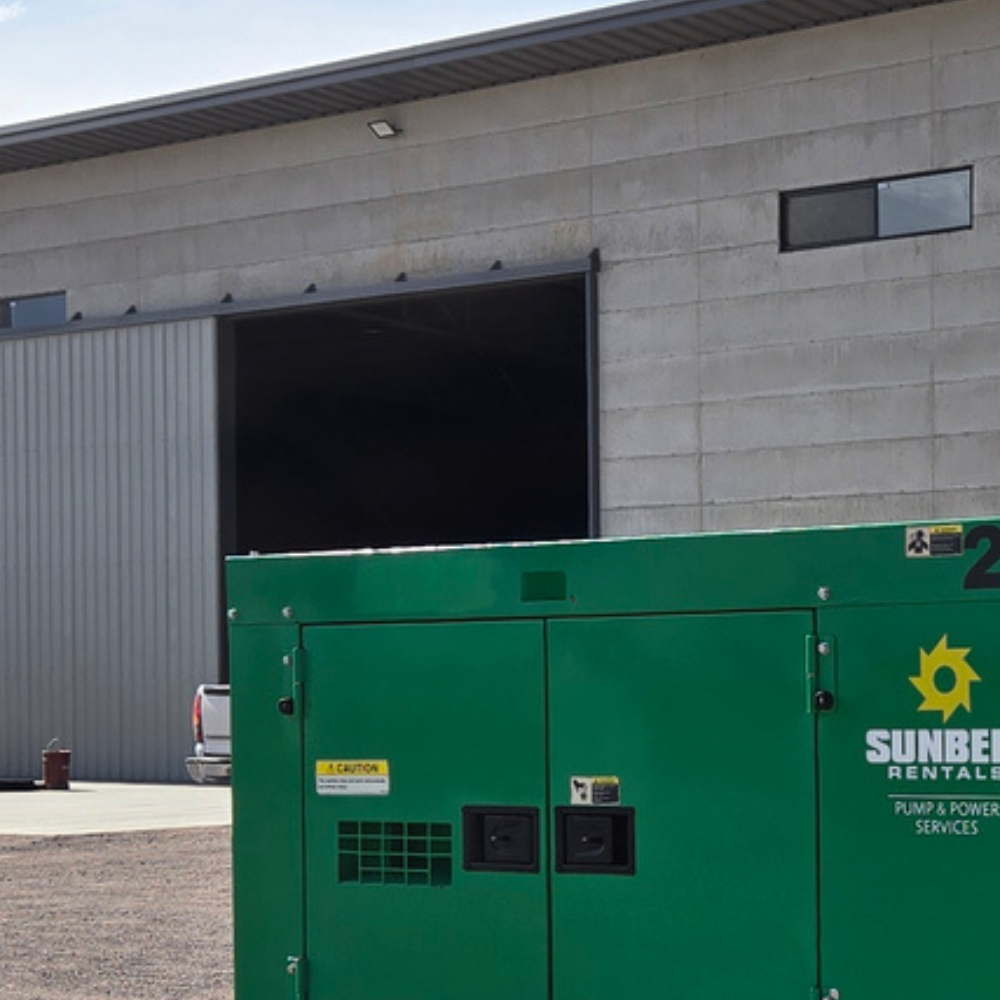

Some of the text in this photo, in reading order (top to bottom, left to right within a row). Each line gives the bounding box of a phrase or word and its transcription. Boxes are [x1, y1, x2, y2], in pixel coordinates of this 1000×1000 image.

[337, 763, 378, 774] CAUTION
[894, 801, 1000, 817] PUMP & POWER
[915, 819, 979, 836] SERVICES
